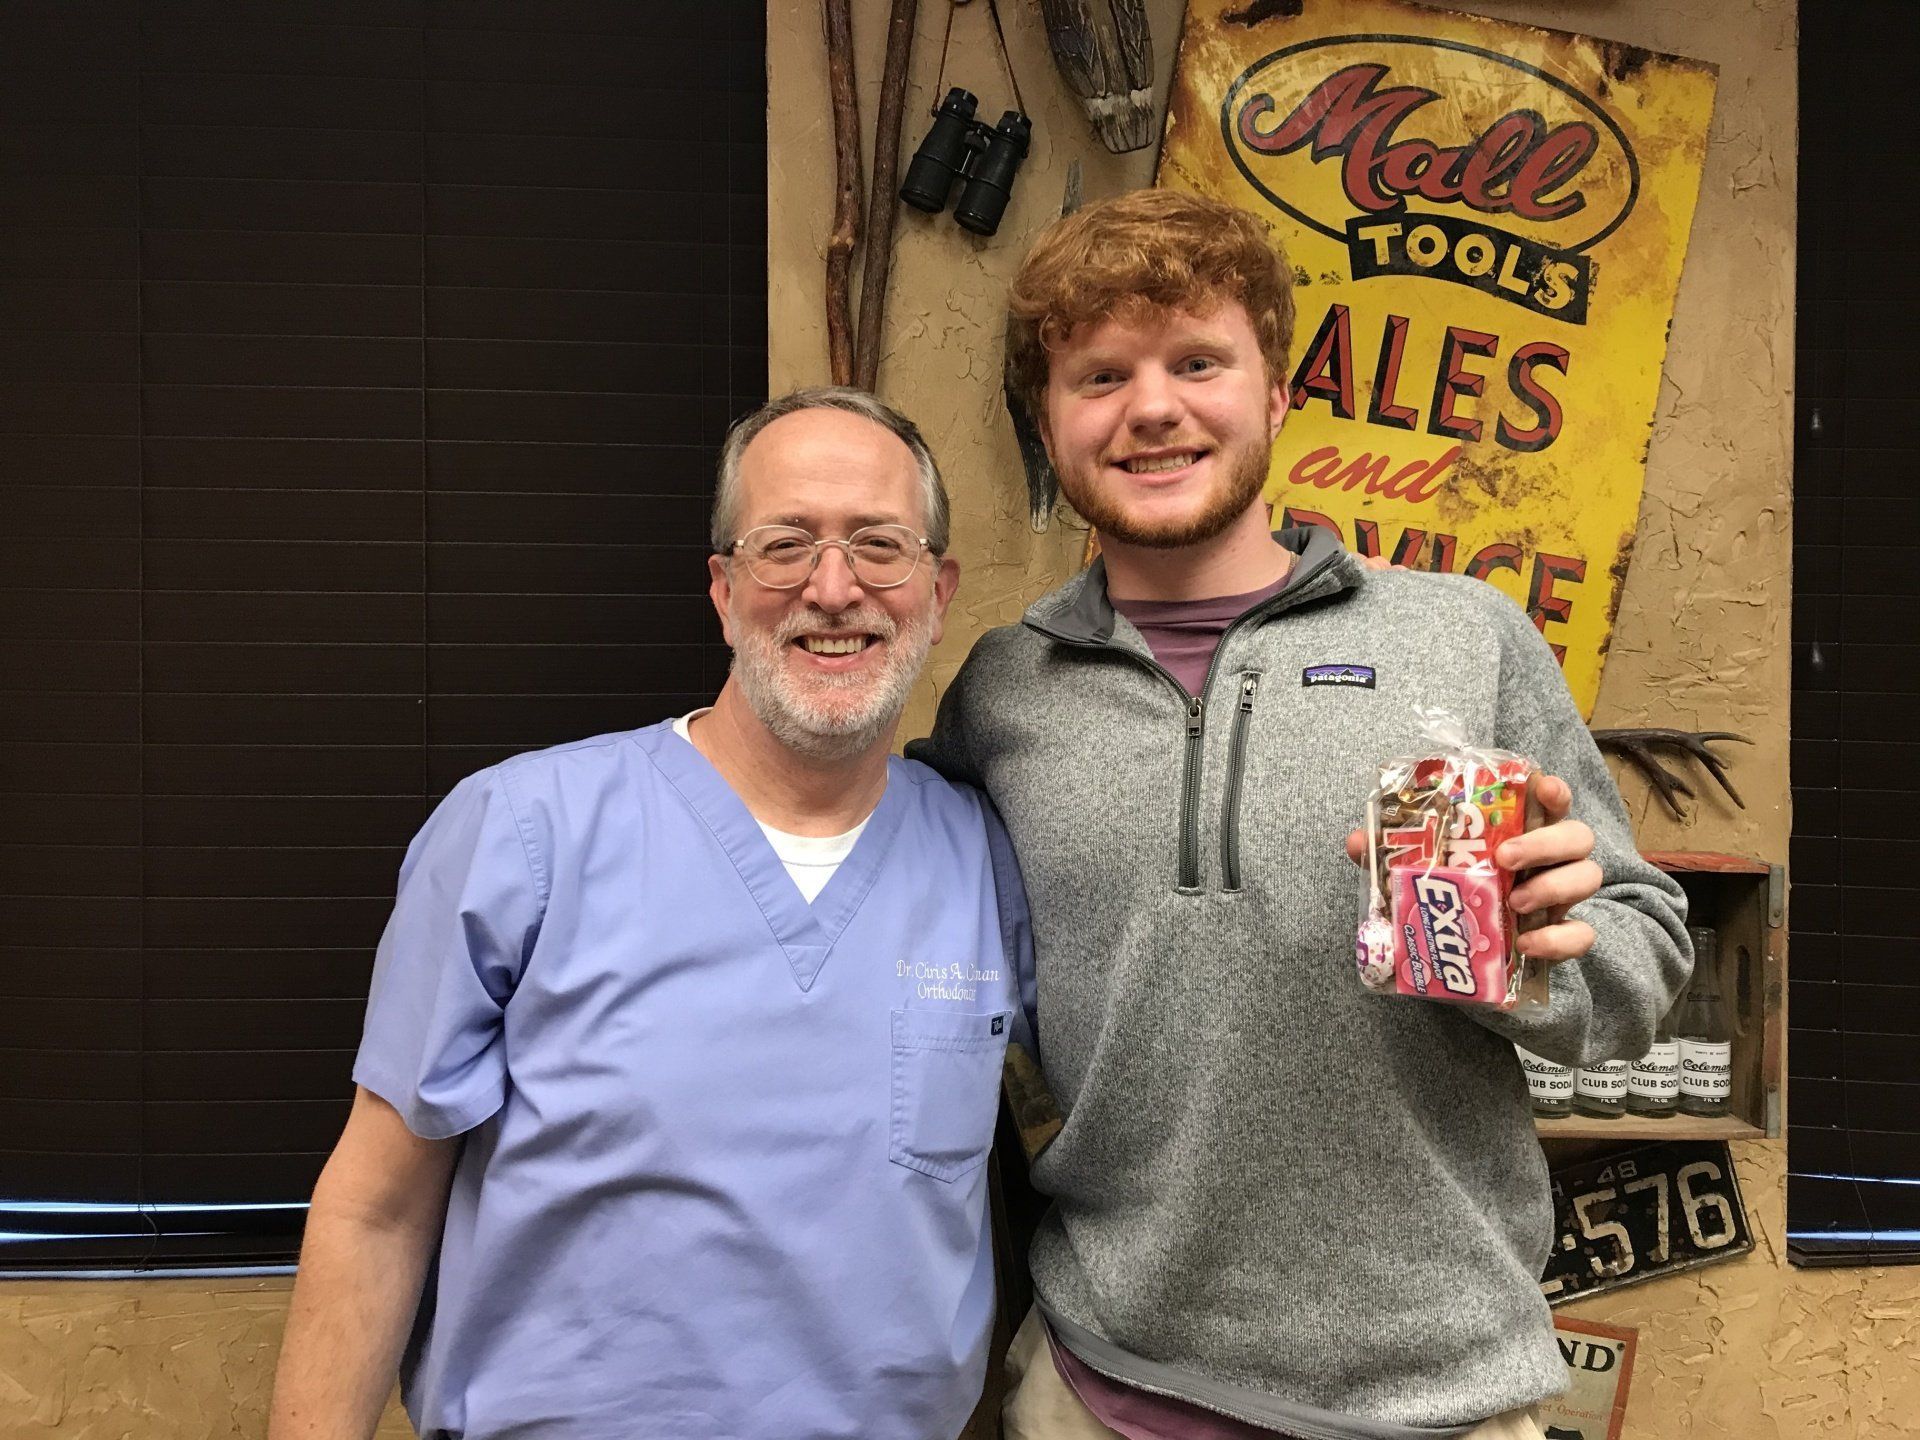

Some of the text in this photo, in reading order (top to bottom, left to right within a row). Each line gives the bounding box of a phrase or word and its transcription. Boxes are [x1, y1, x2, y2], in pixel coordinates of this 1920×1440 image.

[1238, 63, 1600, 221] Mall
[1357, 222, 1580, 310] TOOLS
[1289, 303, 1570, 452] ALES
[1287, 446, 1462, 504] and
[1310, 673, 1367, 684] patagonia
[1413, 876, 1477, 996] Extra
[896, 959, 914, 977] Dr.
[915, 961, 948, 980] Chris
[1411, 959, 1427, 994] BUBBLE
[1527, 1077, 1546, 1088] LUB
[1582, 1077, 1608, 1088] CLUB
[1631, 1076, 1679, 1088] CLUB SOD
[1682, 1076, 1731, 1088] CLUB SOD
[1557, 1337, 1616, 1373] ND
